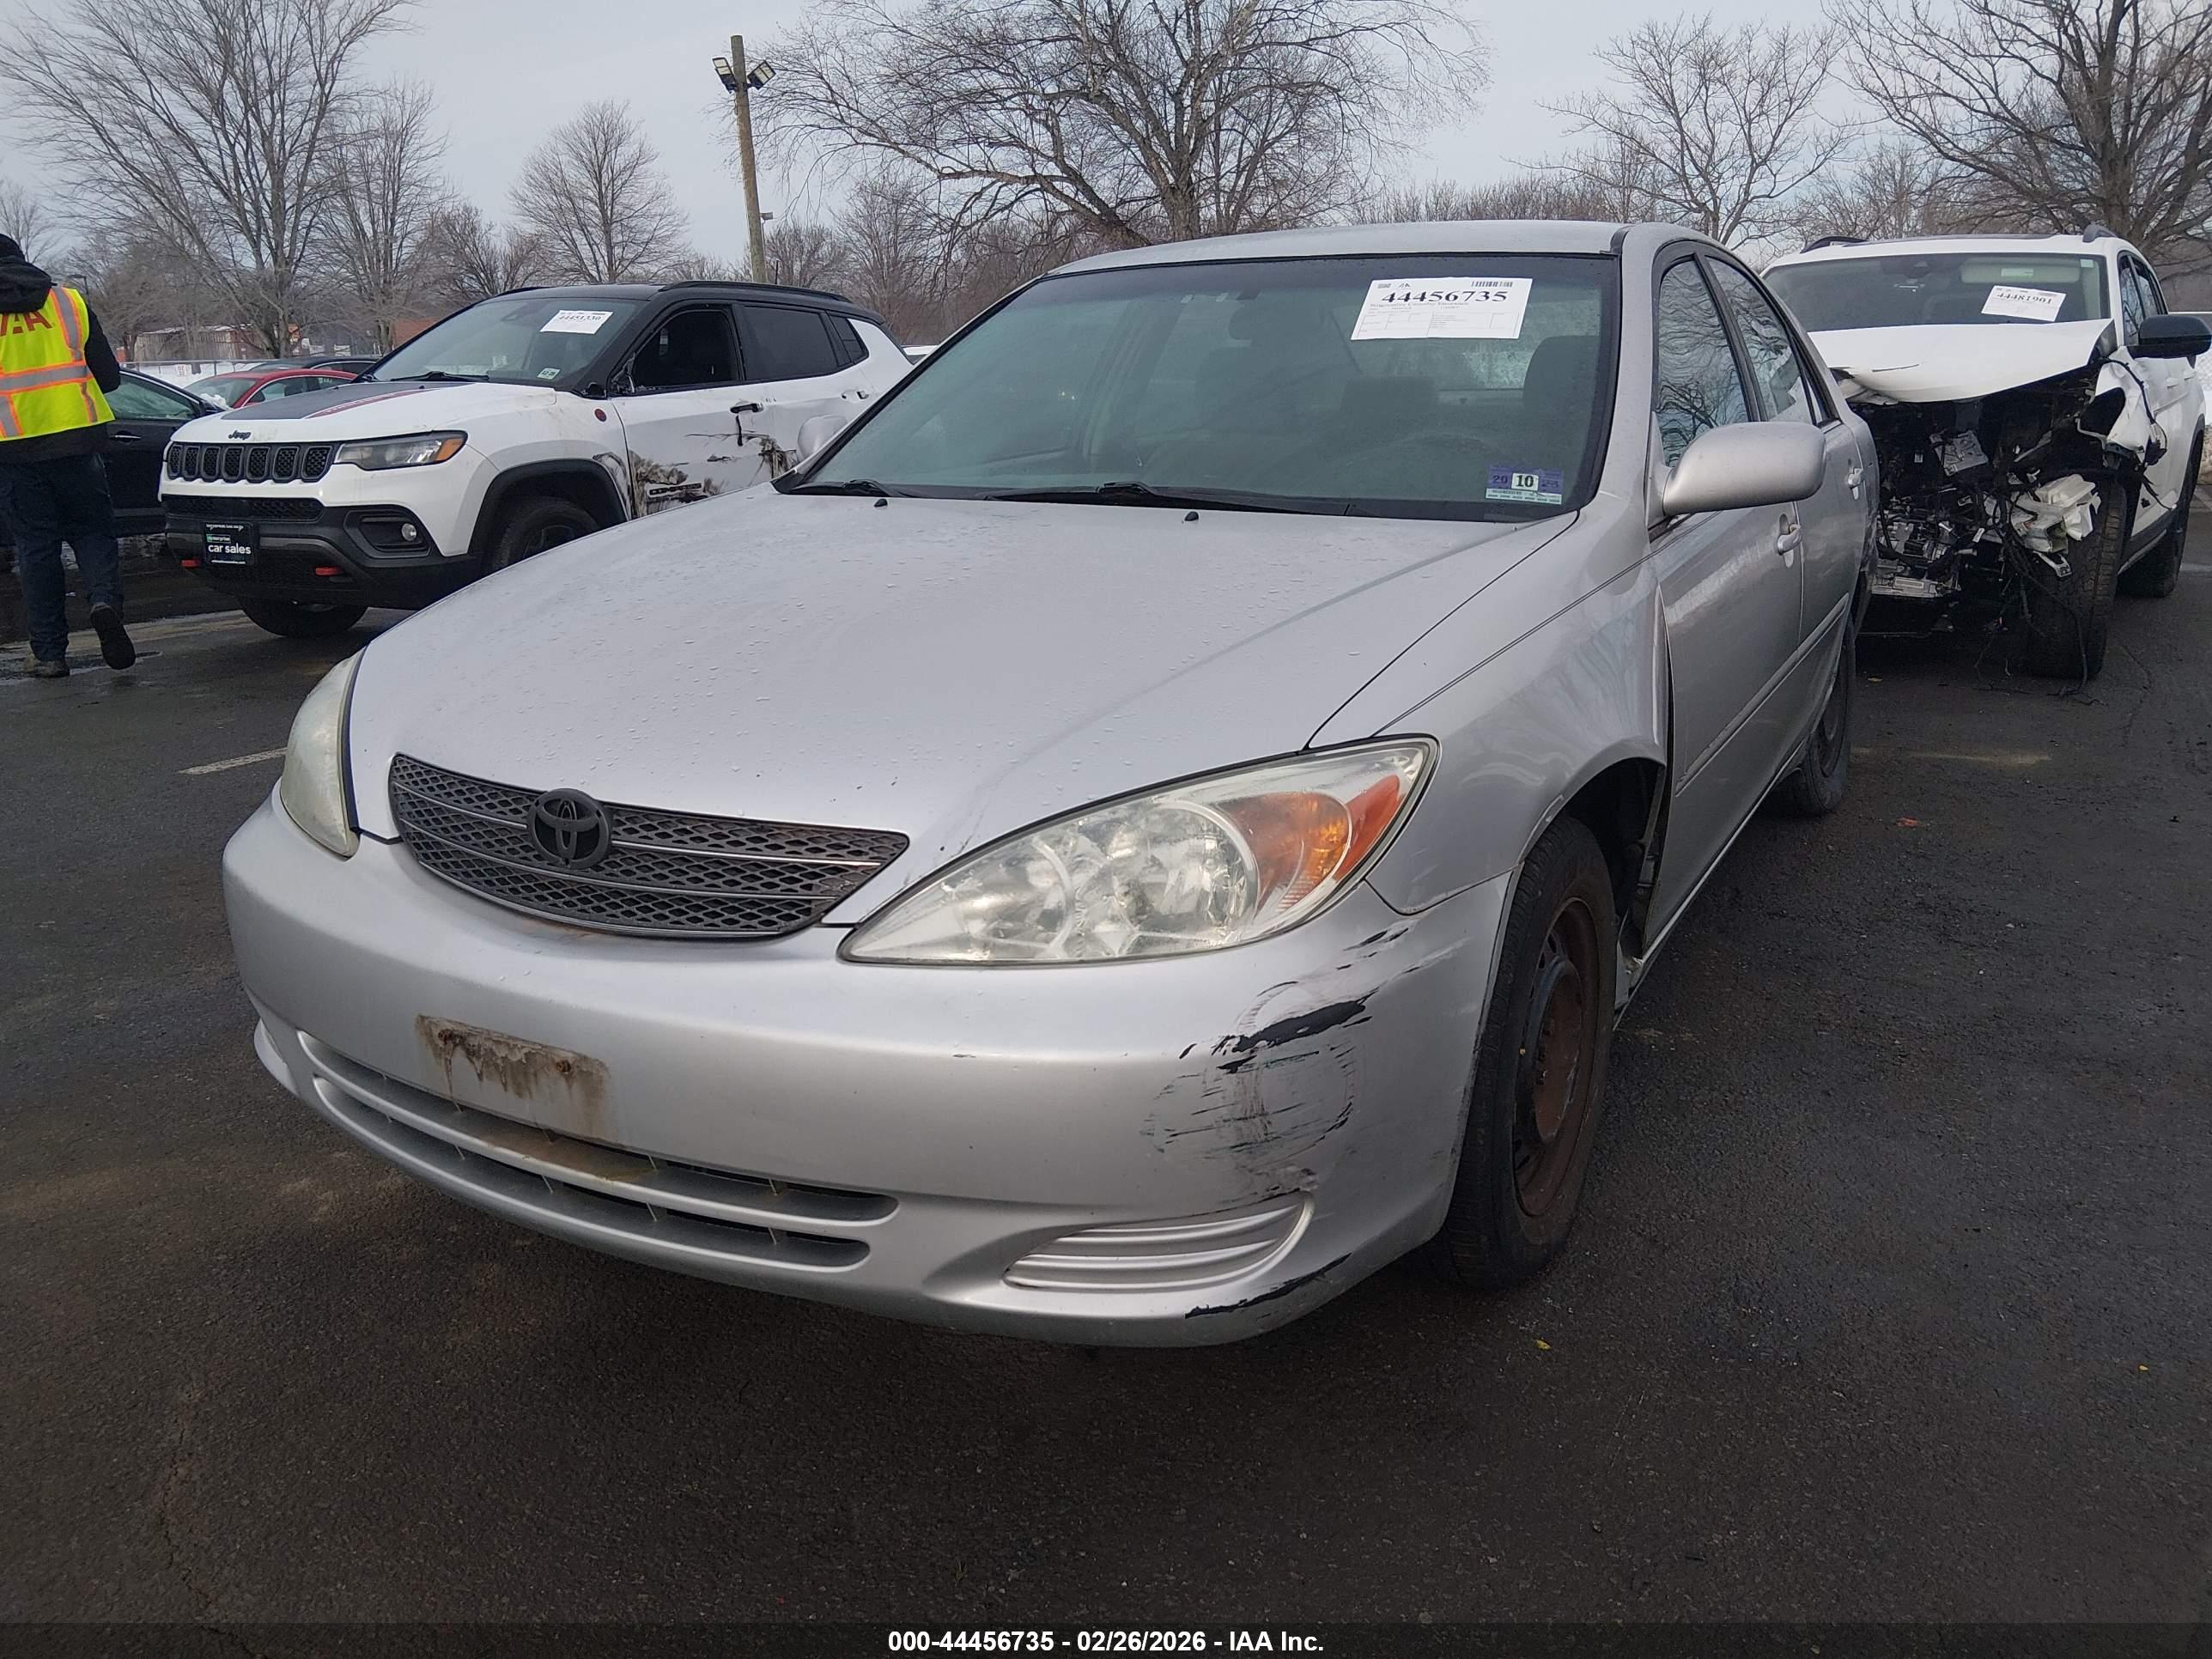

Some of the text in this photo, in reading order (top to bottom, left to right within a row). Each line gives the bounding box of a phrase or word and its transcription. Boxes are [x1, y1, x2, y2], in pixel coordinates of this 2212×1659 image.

[1382, 290, 1509, 303] 44456735
[1996, 293, 2052, 305] 44481901
[228, 429, 252, 441] Jeep
[1516, 474, 1534, 488] 10
[208, 543, 252, 555] car sales
